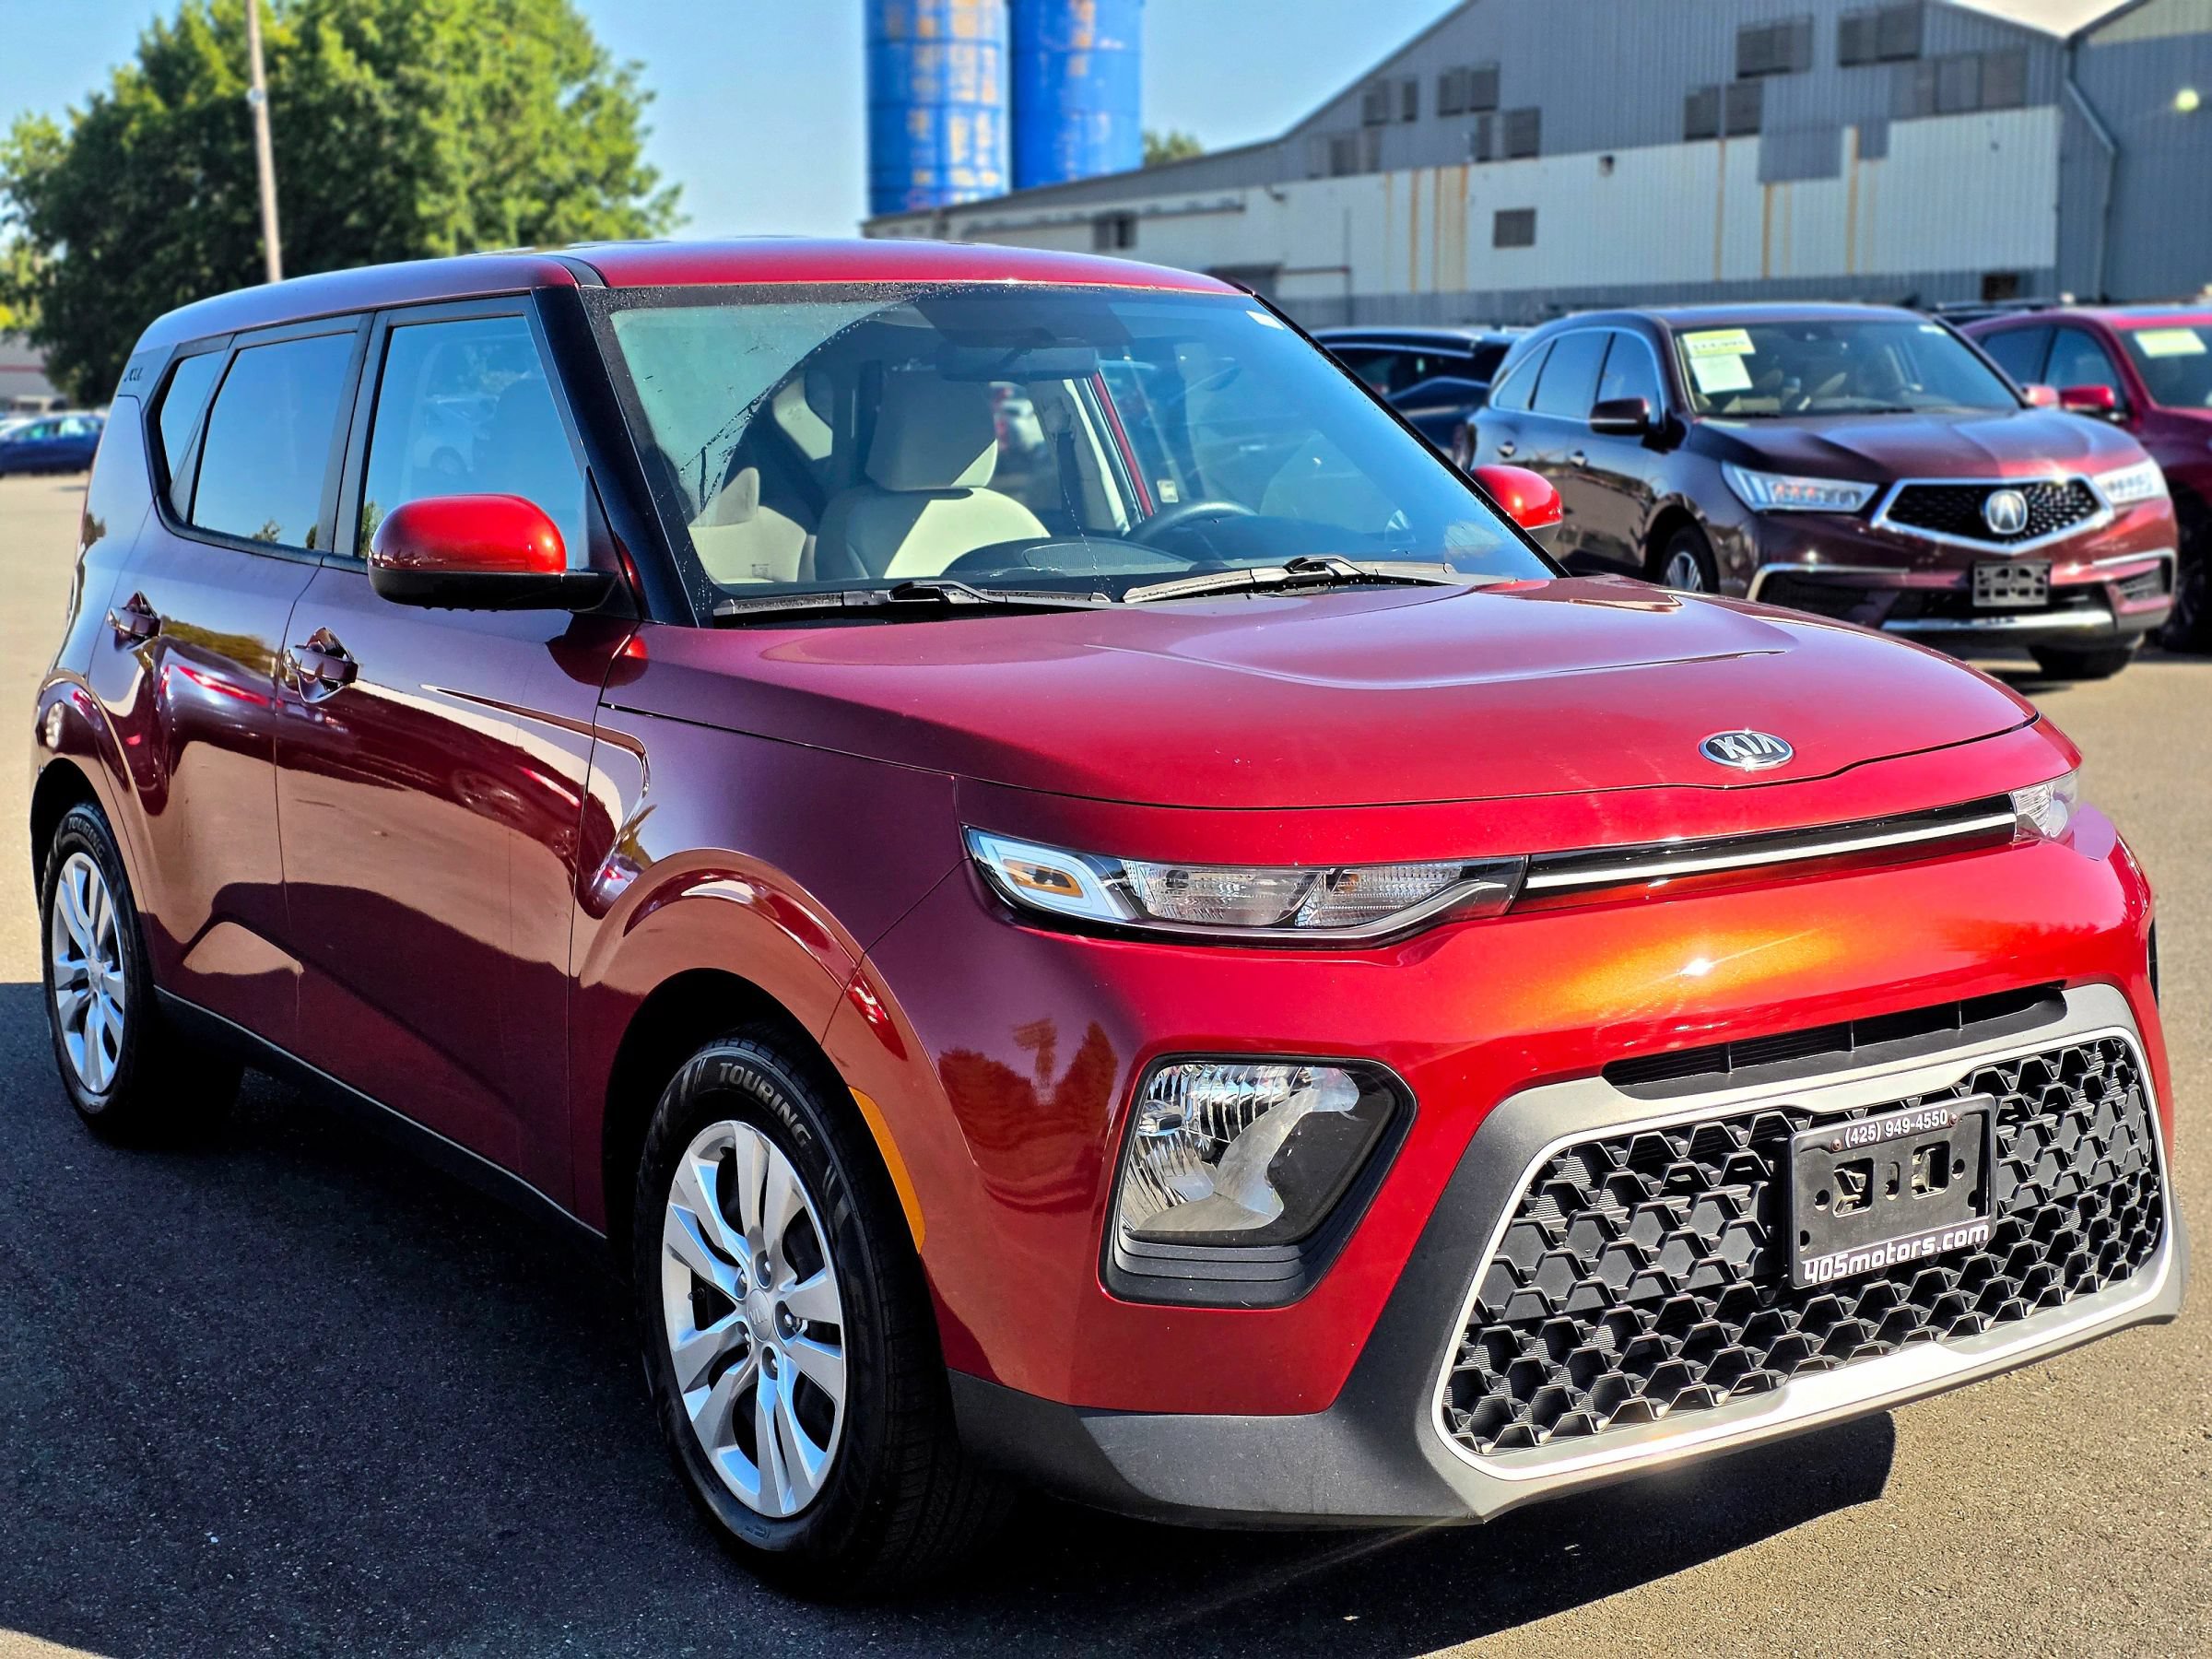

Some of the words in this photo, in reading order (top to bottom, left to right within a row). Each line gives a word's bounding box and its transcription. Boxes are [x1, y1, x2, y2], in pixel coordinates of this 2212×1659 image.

[1711, 734, 1786, 759] KIA
[719, 1062, 812, 1147] TOURING
[1844, 1121, 1881, 1148] (425)
[1885, 1109, 1948, 1138] 949-4550
[1803, 1223, 1989, 1284] 405motors.com
